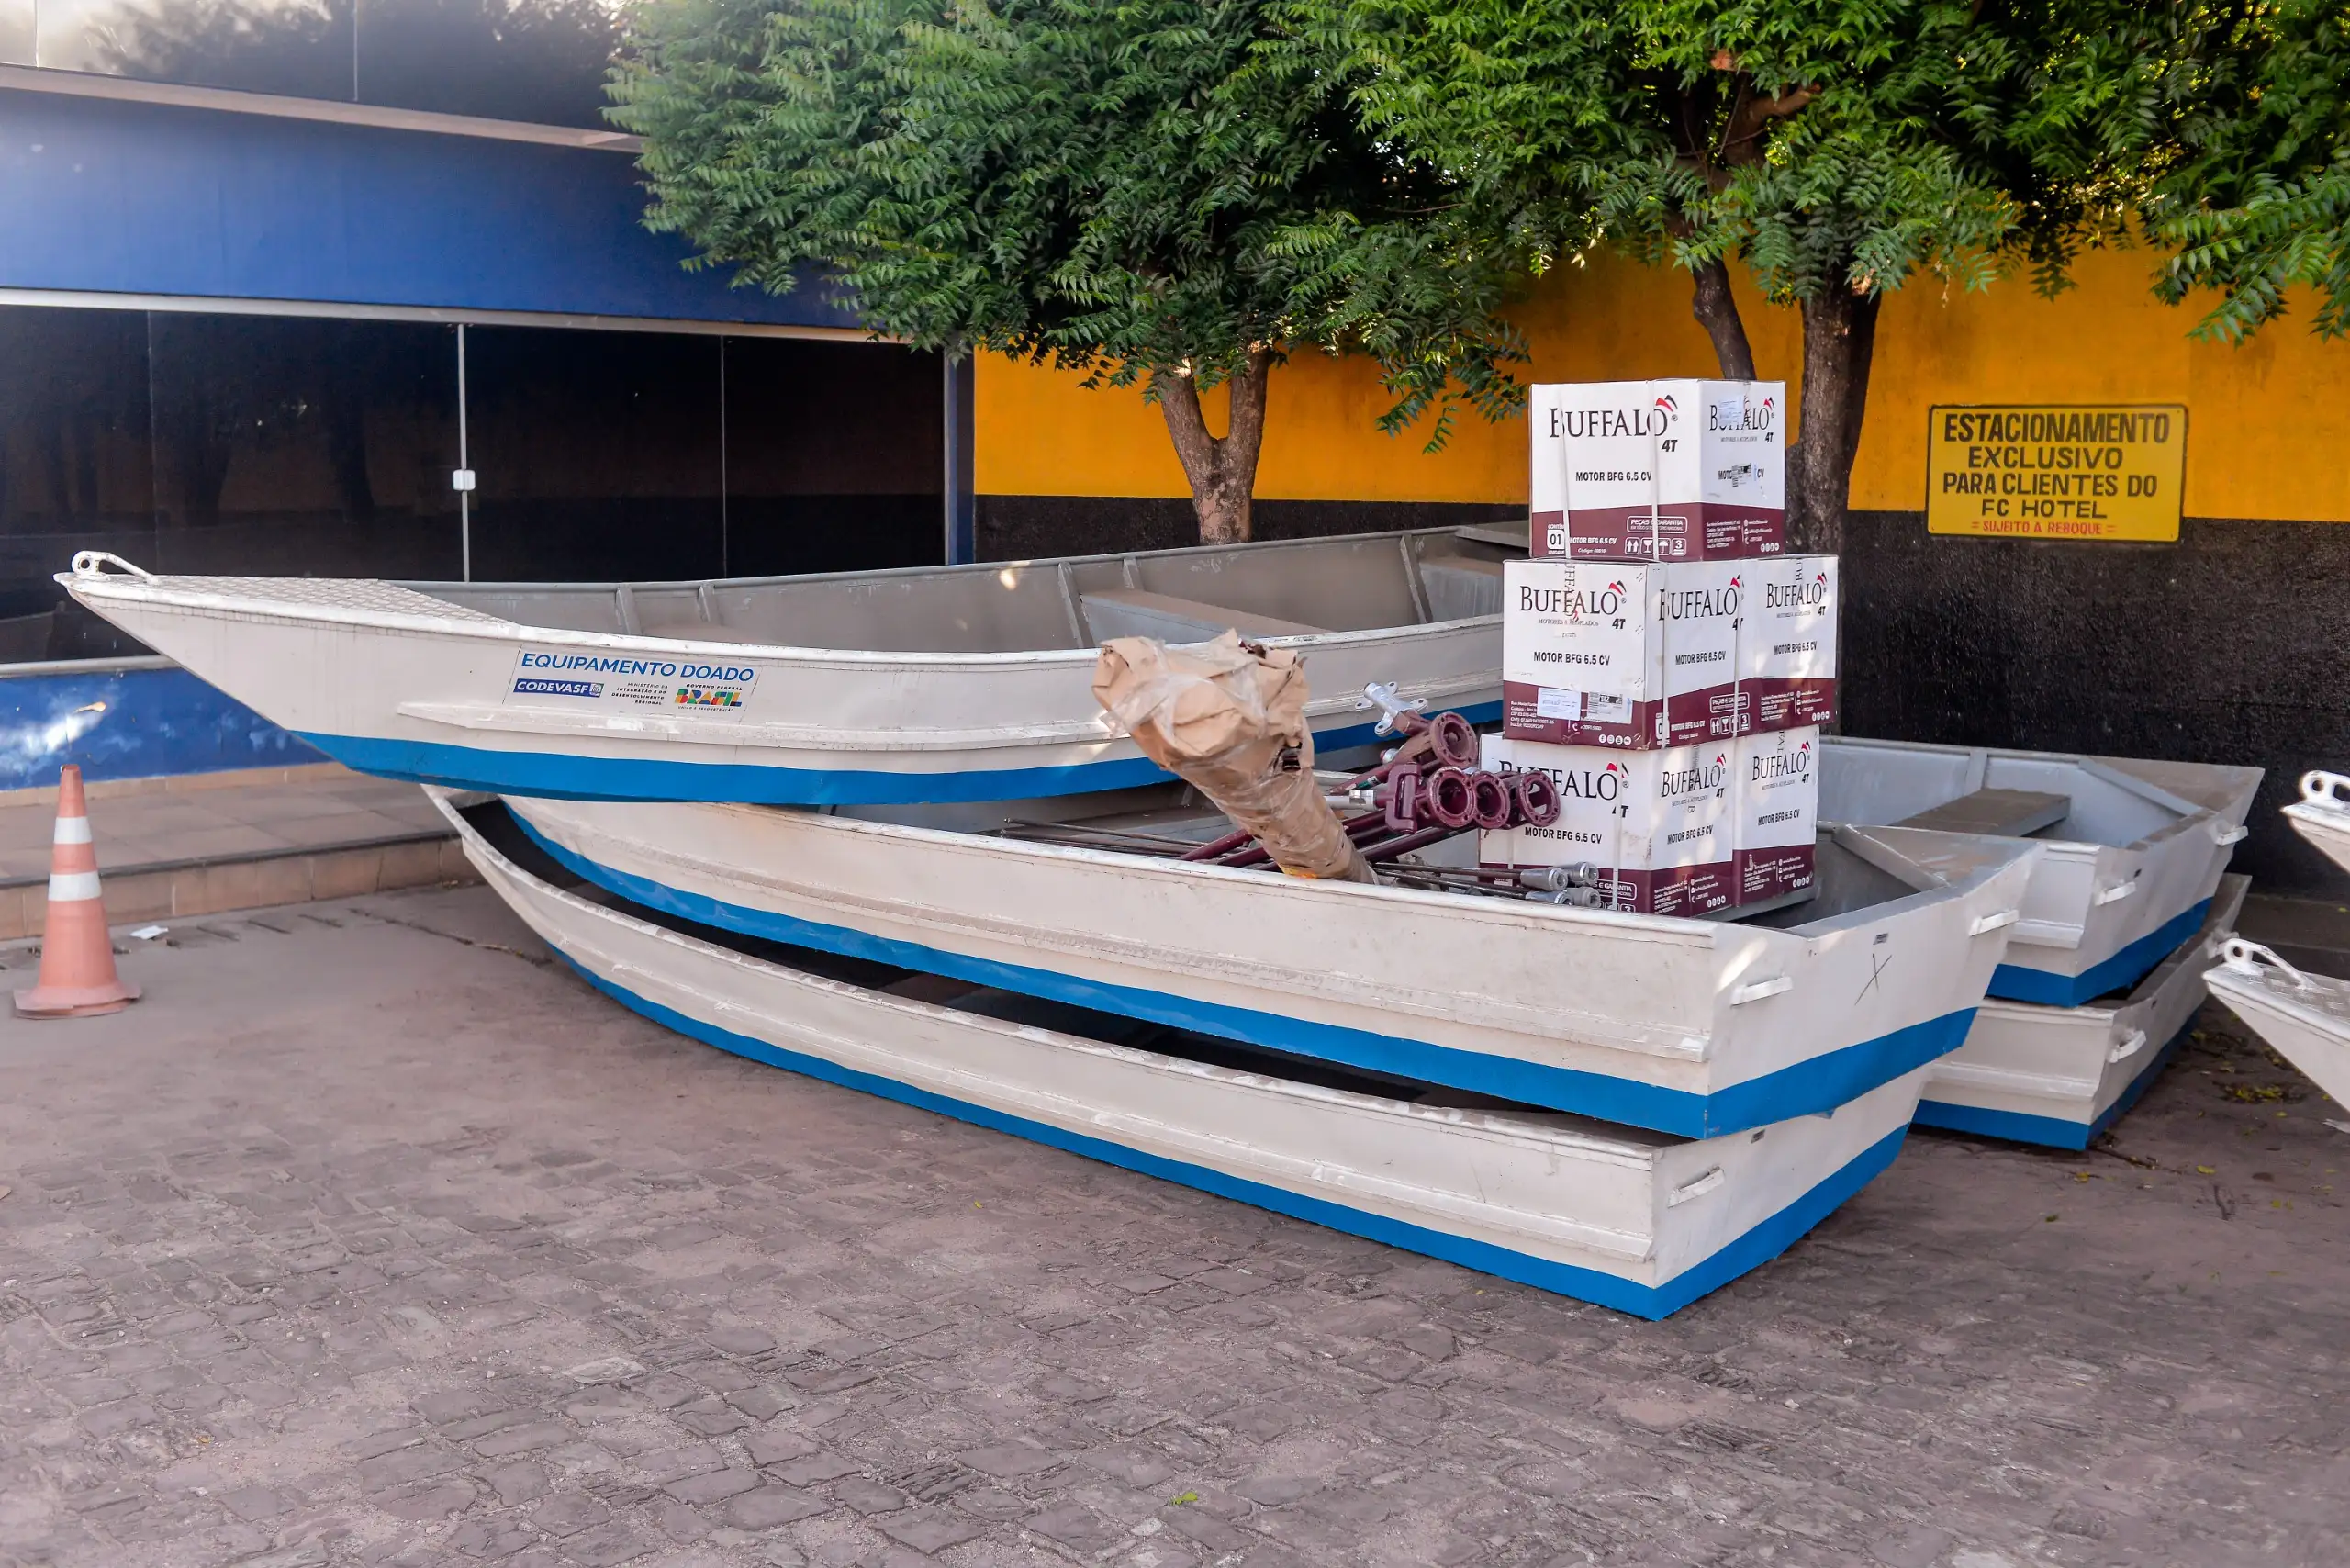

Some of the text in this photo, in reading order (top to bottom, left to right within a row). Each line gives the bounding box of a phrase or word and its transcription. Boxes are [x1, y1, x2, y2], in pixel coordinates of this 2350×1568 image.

[1549, 408, 1668, 438] BUFFALO
[1943, 412, 2171, 444] ESTACIONAMENTO
[1661, 439, 1679, 453] 4T
[1764, 431, 1774, 443] 4T
[1967, 445, 2124, 470] EXCLUSIVO
[1575, 471, 1652, 482] MOTOR BFG 6.5 CV
[1942, 472, 2157, 498] PARA CLIENTES DO
[1981, 498, 2108, 519] FC HOTEL
[1982, 520, 2102, 535] SUJEITO A REBOQUE
[1550, 533, 1561, 545] 01
[1519, 585, 1618, 616] BUFFALO
[1765, 581, 1822, 609] BUFFALO
[1817, 605, 1827, 617] 4T
[1612, 618, 1626, 630] 4T
[1533, 651, 1611, 666] MOTOR BFG 6.5 CV
[1675, 650, 1727, 666] MOTOR BFG 6.5 CV
[1774, 644, 1791, 655] MOTOR
[520, 652, 755, 682] EQUIPAMENTO DOADO
[516, 681, 589, 695] CODEVASF
[675, 689, 743, 707] BRASIL
[1751, 751, 1807, 781] BUFFALO
[1661, 764, 1721, 798] BUFFALO
[1801, 773, 1810, 784] 4T
[1715, 787, 1725, 799] 4T
[1758, 814, 1775, 826] MOTOR
[1774, 812, 1785, 823] BFG
[1793, 808, 1800, 819] CV
[1525, 826, 1603, 845] MOTOR BFG 6.5 CV
[1667, 830, 1685, 845] MOTOR
[1685, 828, 1696, 840] BFG
[1705, 825, 1714, 836] CV
